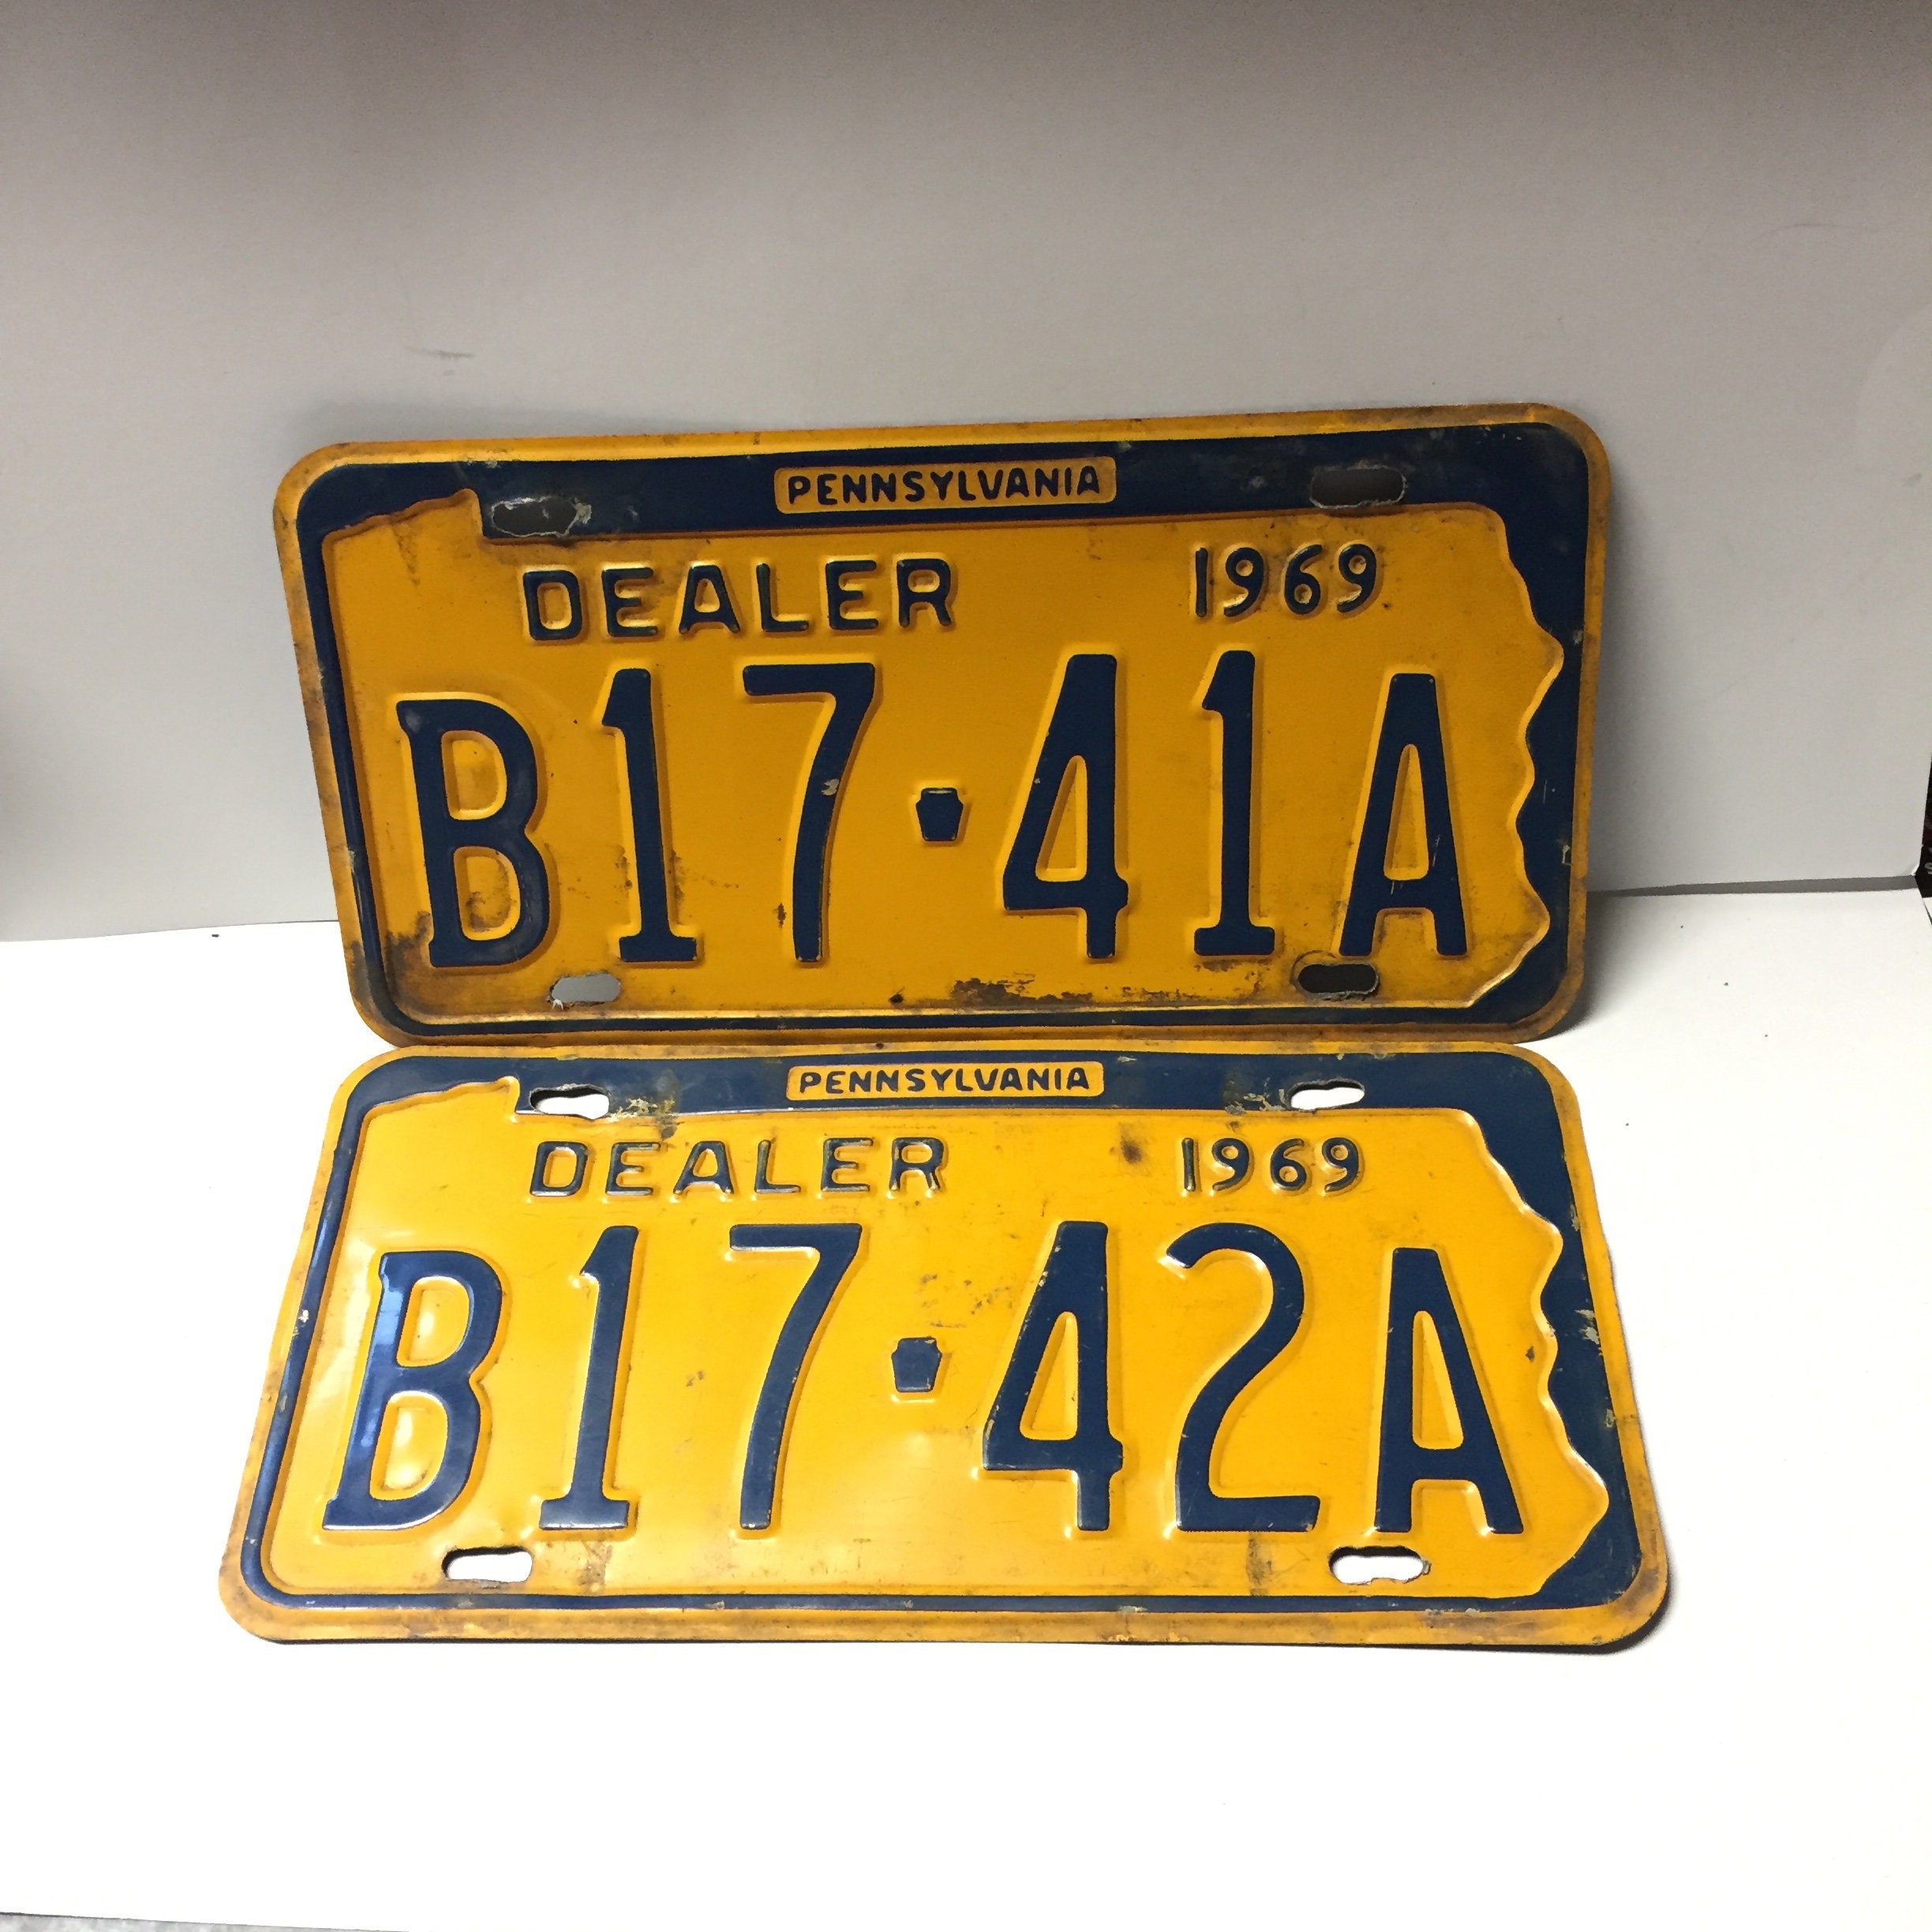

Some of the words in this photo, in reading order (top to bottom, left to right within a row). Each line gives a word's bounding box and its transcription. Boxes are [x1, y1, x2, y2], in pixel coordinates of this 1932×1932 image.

[788, 465, 1101, 506] PENNSYLVANIA
[521, 557, 954, 642] DEALER
[1194, 543, 1379, 619] 1969
[799, 1067, 1090, 1095] PENNSYLVANIA
[529, 1136, 945, 1196] DEALER
[1181, 1136, 1361, 1193] 1969
